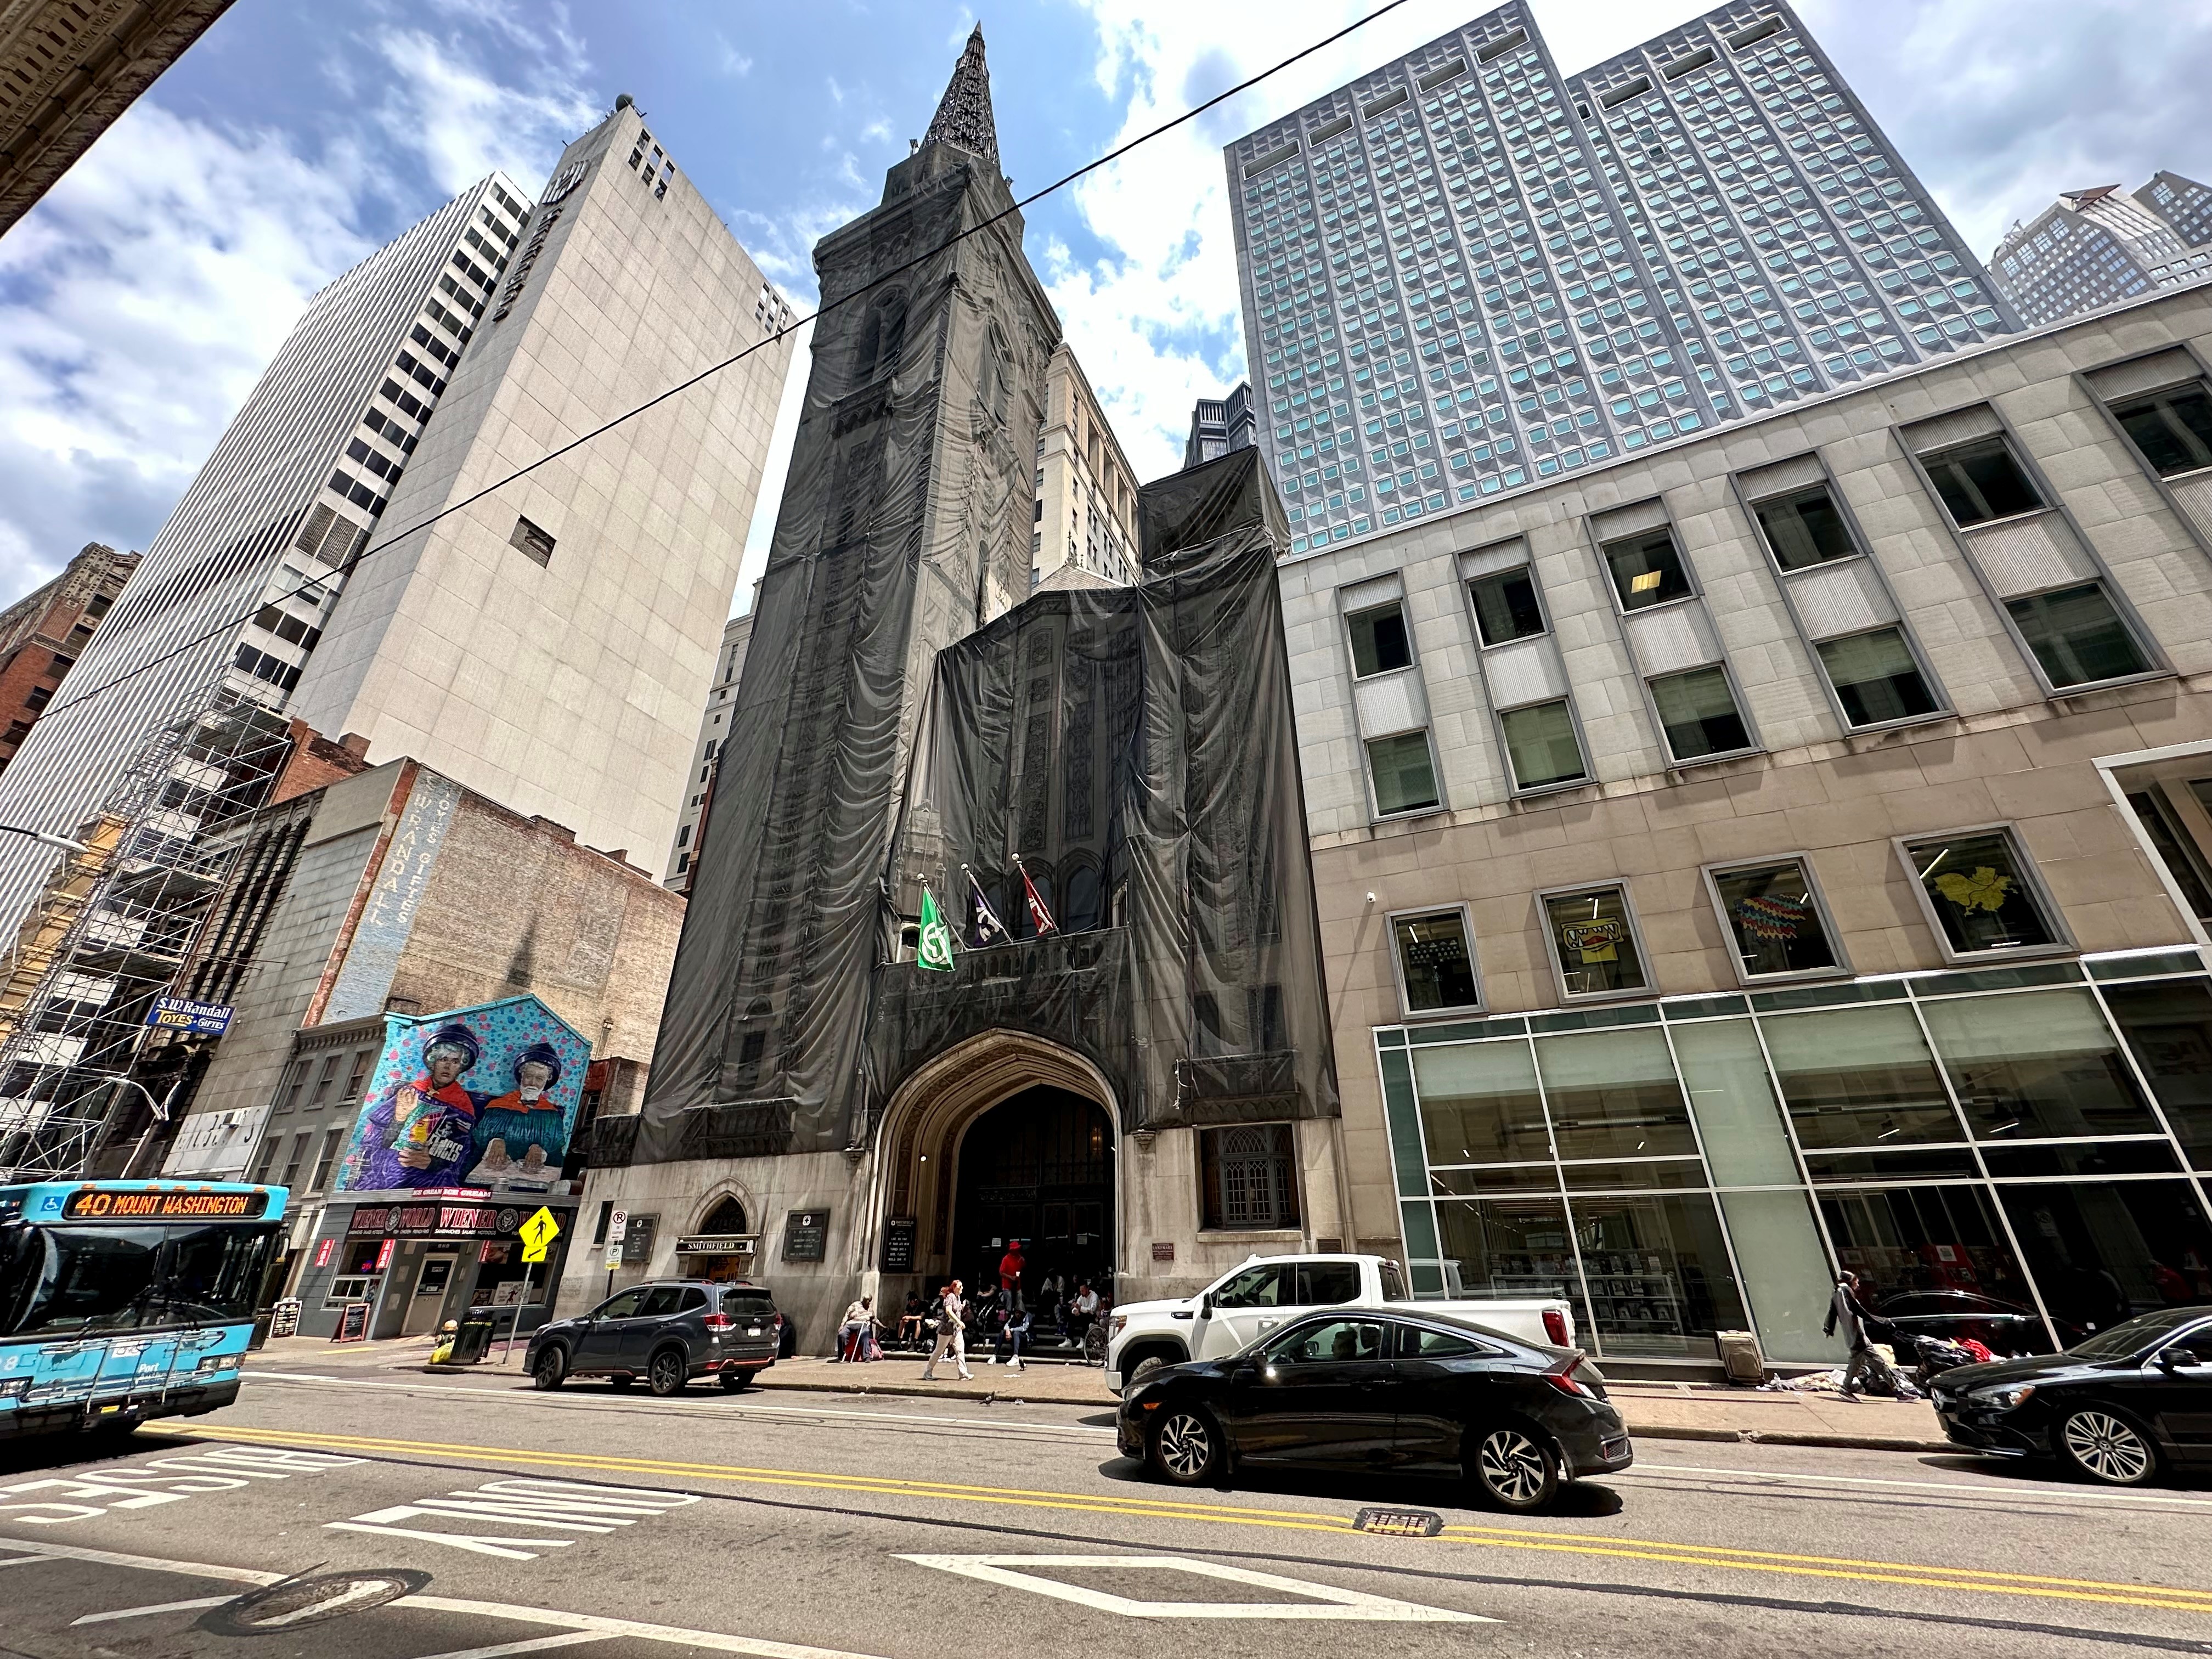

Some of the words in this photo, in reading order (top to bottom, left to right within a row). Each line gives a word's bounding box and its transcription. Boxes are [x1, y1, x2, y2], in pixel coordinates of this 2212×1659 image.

[427, 791, 450, 844] OYES
[155, 1009, 194, 1026] TOYES
[198, 1018, 225, 1030] GIFTES
[183, 1001, 231, 1019] Randall
[75, 1194, 111, 1216] 40
[111, 1195, 162, 1215] MOUNT
[161, 1195, 249, 1215] WASHINGTON
[352, 1209, 388, 1229] WIENER
[398, 1207, 436, 1228] WORLD
[439, 1206, 497, 1229] WIENER
[1, 1356, 19, 1370] 8
[139, 1363, 160, 1373] Port
[322, 1479, 702, 1561] ONLY
